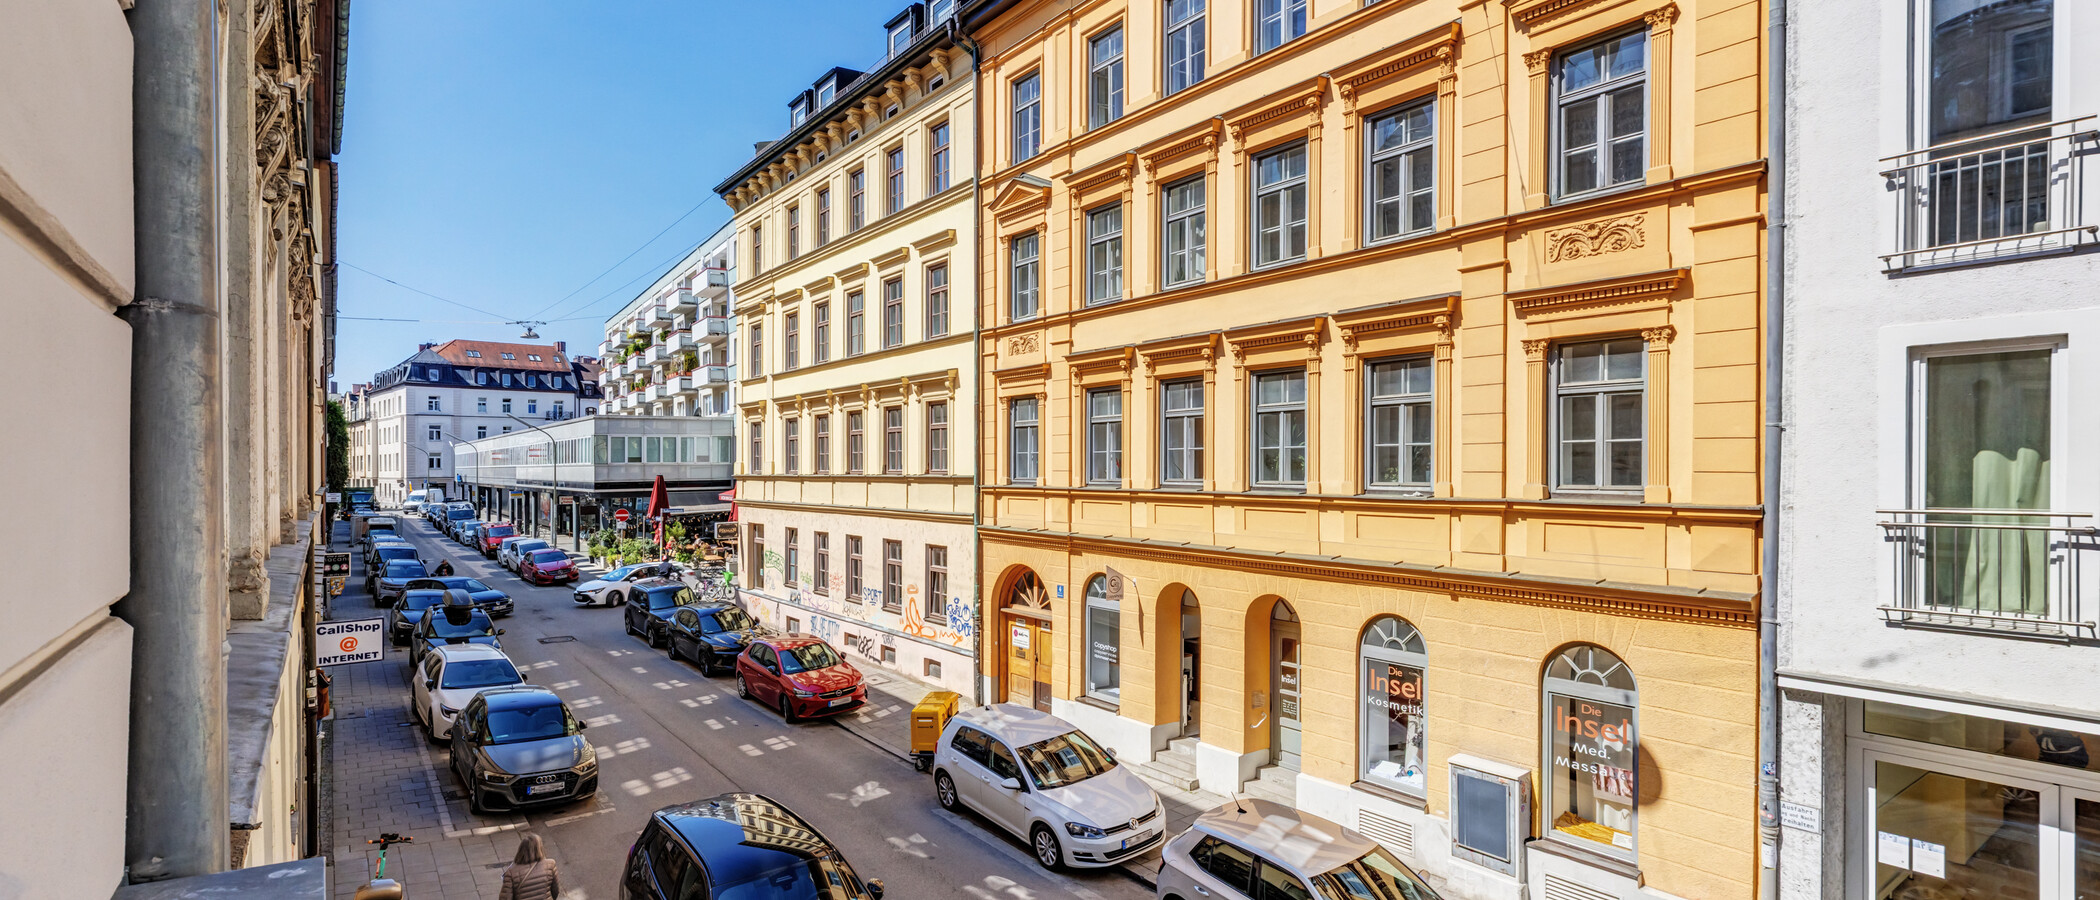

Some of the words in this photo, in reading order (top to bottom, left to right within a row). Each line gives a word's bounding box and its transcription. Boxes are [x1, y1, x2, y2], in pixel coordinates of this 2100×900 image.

[316, 623, 380, 635] CallShop
[339, 636, 358, 652] @
[1094, 641, 1117, 653] Copyshop
[318, 651, 379, 664] INTERNET
[1388, 666, 1402, 677] Die
[1281, 674, 1296, 685] Insel
[1370, 668, 1422, 700] Insel
[1367, 695, 1423, 716] Kosmetik
[1581, 703, 1602, 717] Die
[1556, 705, 1628, 745] Insel
[1573, 742, 1611, 760] Med.
[1555, 755, 1628, 781] Massae
[1781, 803, 1813, 815] Ausfahrt
[1782, 818, 1815, 829] reihalten
